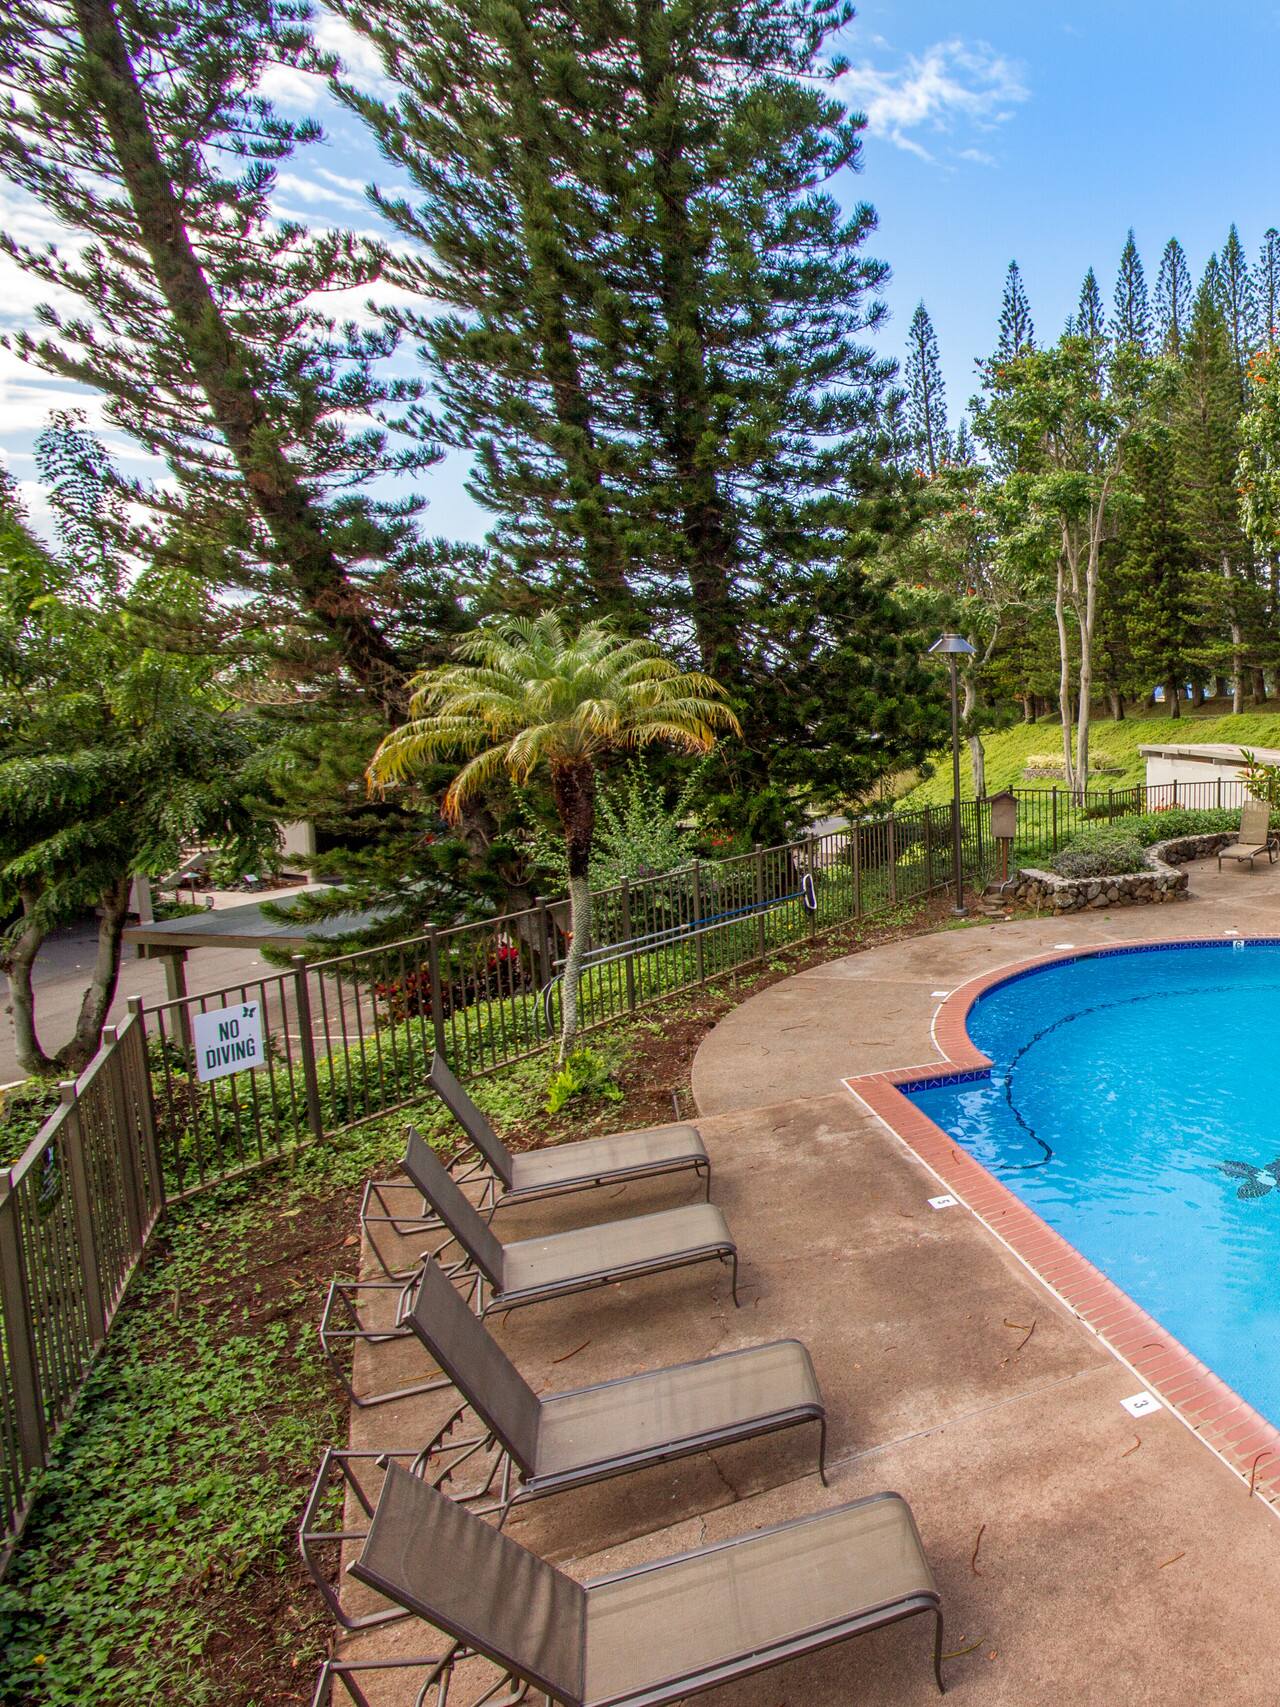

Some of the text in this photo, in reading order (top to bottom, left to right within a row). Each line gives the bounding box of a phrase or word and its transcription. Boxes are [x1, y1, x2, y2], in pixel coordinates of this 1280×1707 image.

[219, 1019, 240, 1041] NO
[206, 1038, 256, 1069] DIVING
[1133, 1399, 1149, 1409] 3
